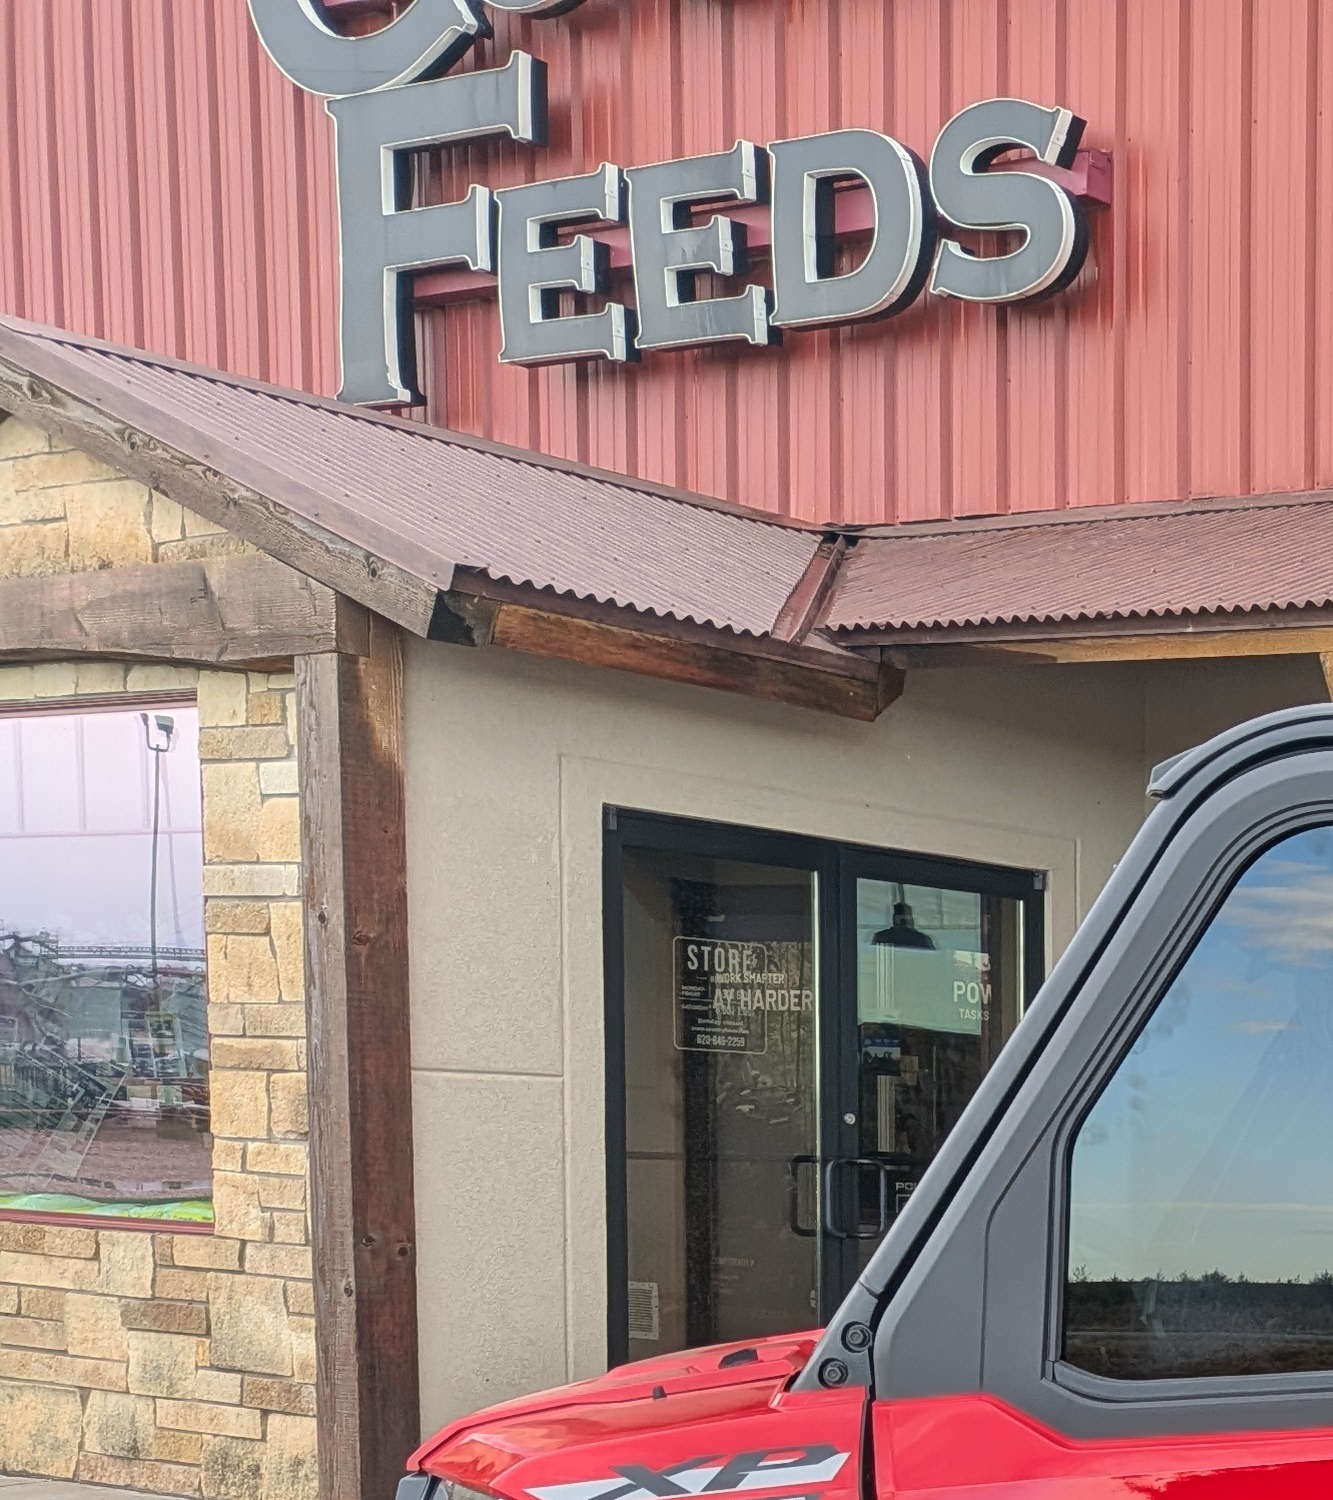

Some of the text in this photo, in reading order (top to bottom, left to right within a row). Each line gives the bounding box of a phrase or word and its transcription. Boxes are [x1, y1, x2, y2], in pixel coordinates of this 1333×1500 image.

[325, 49, 1088, 405] FEEDS
[687, 944, 753, 974] STORE
[743, 972, 785, 984] SMARTER
[740, 988, 813, 1011] HARDER
[959, 1008, 990, 1021] TASKS
